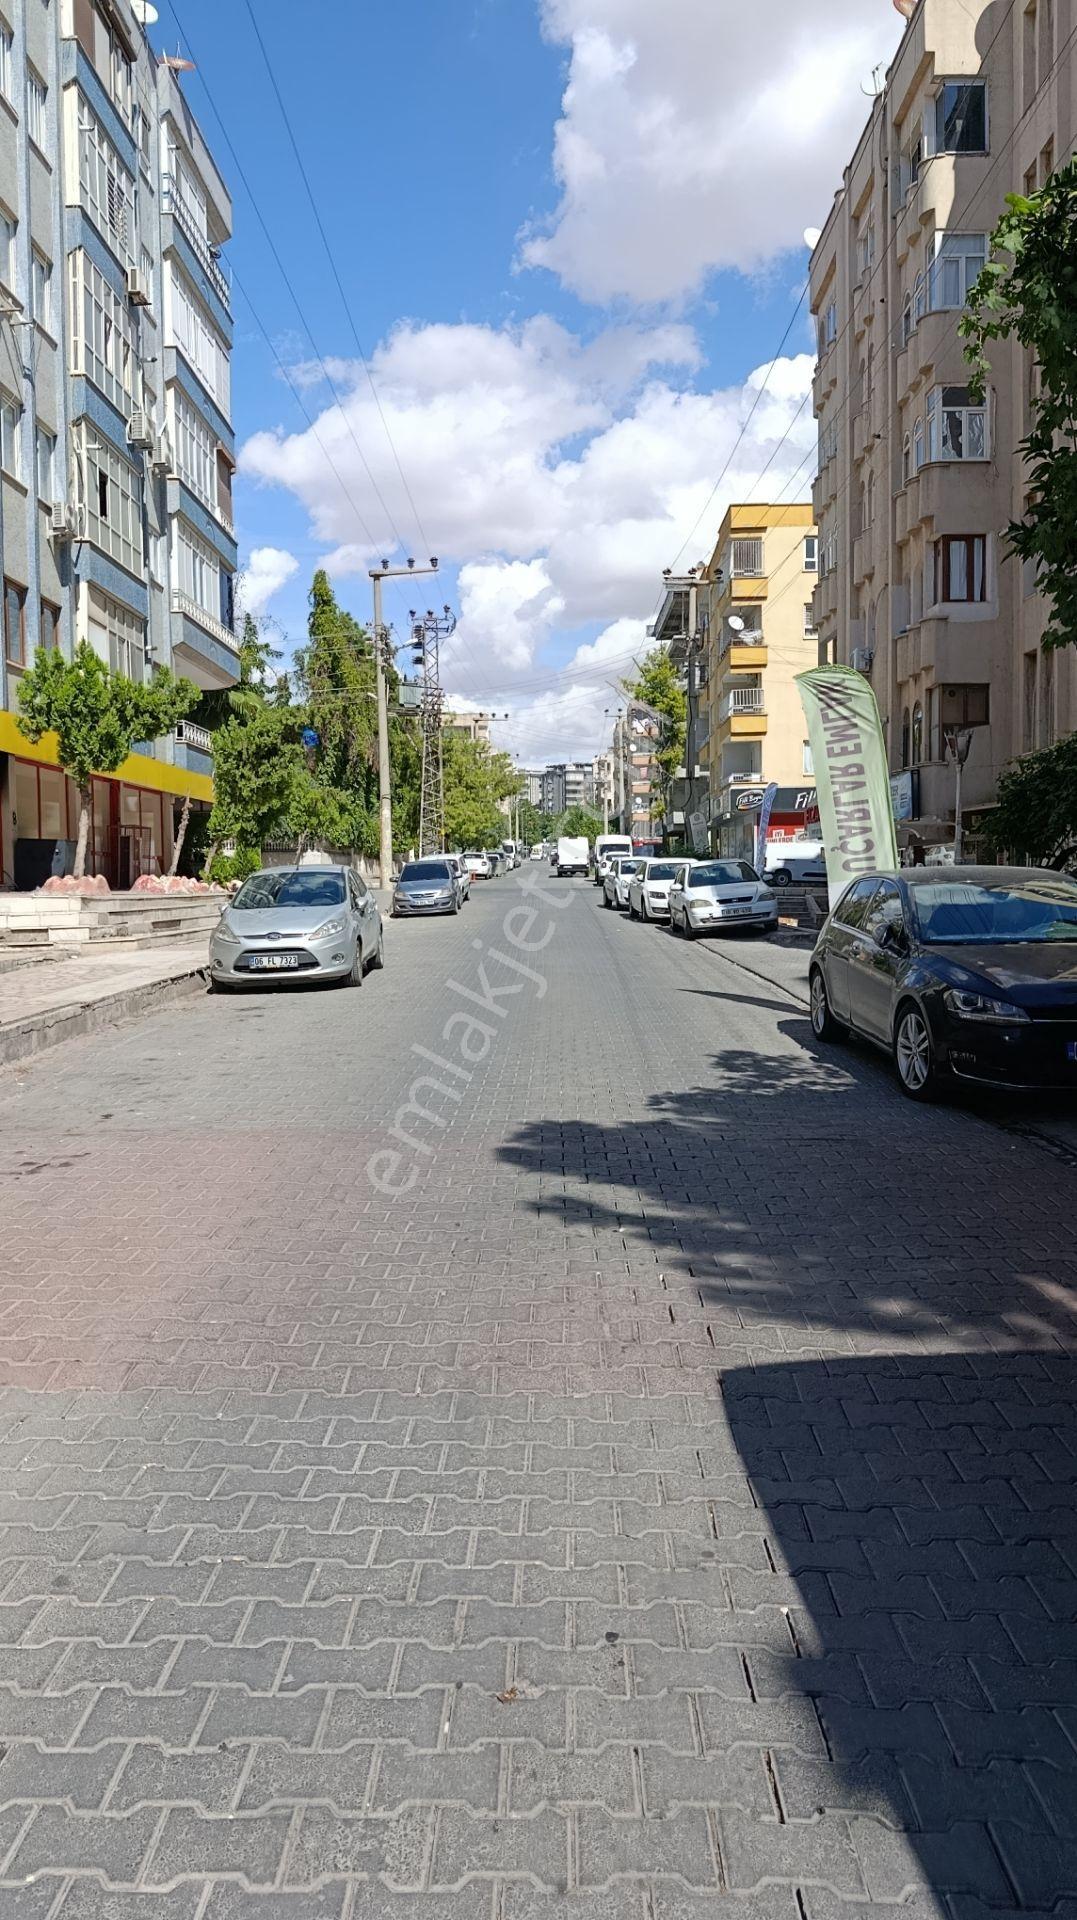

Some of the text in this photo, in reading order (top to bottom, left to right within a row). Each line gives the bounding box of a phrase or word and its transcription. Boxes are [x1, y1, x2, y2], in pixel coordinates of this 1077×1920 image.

[254, 956, 297, 966] 06 FL 7323
